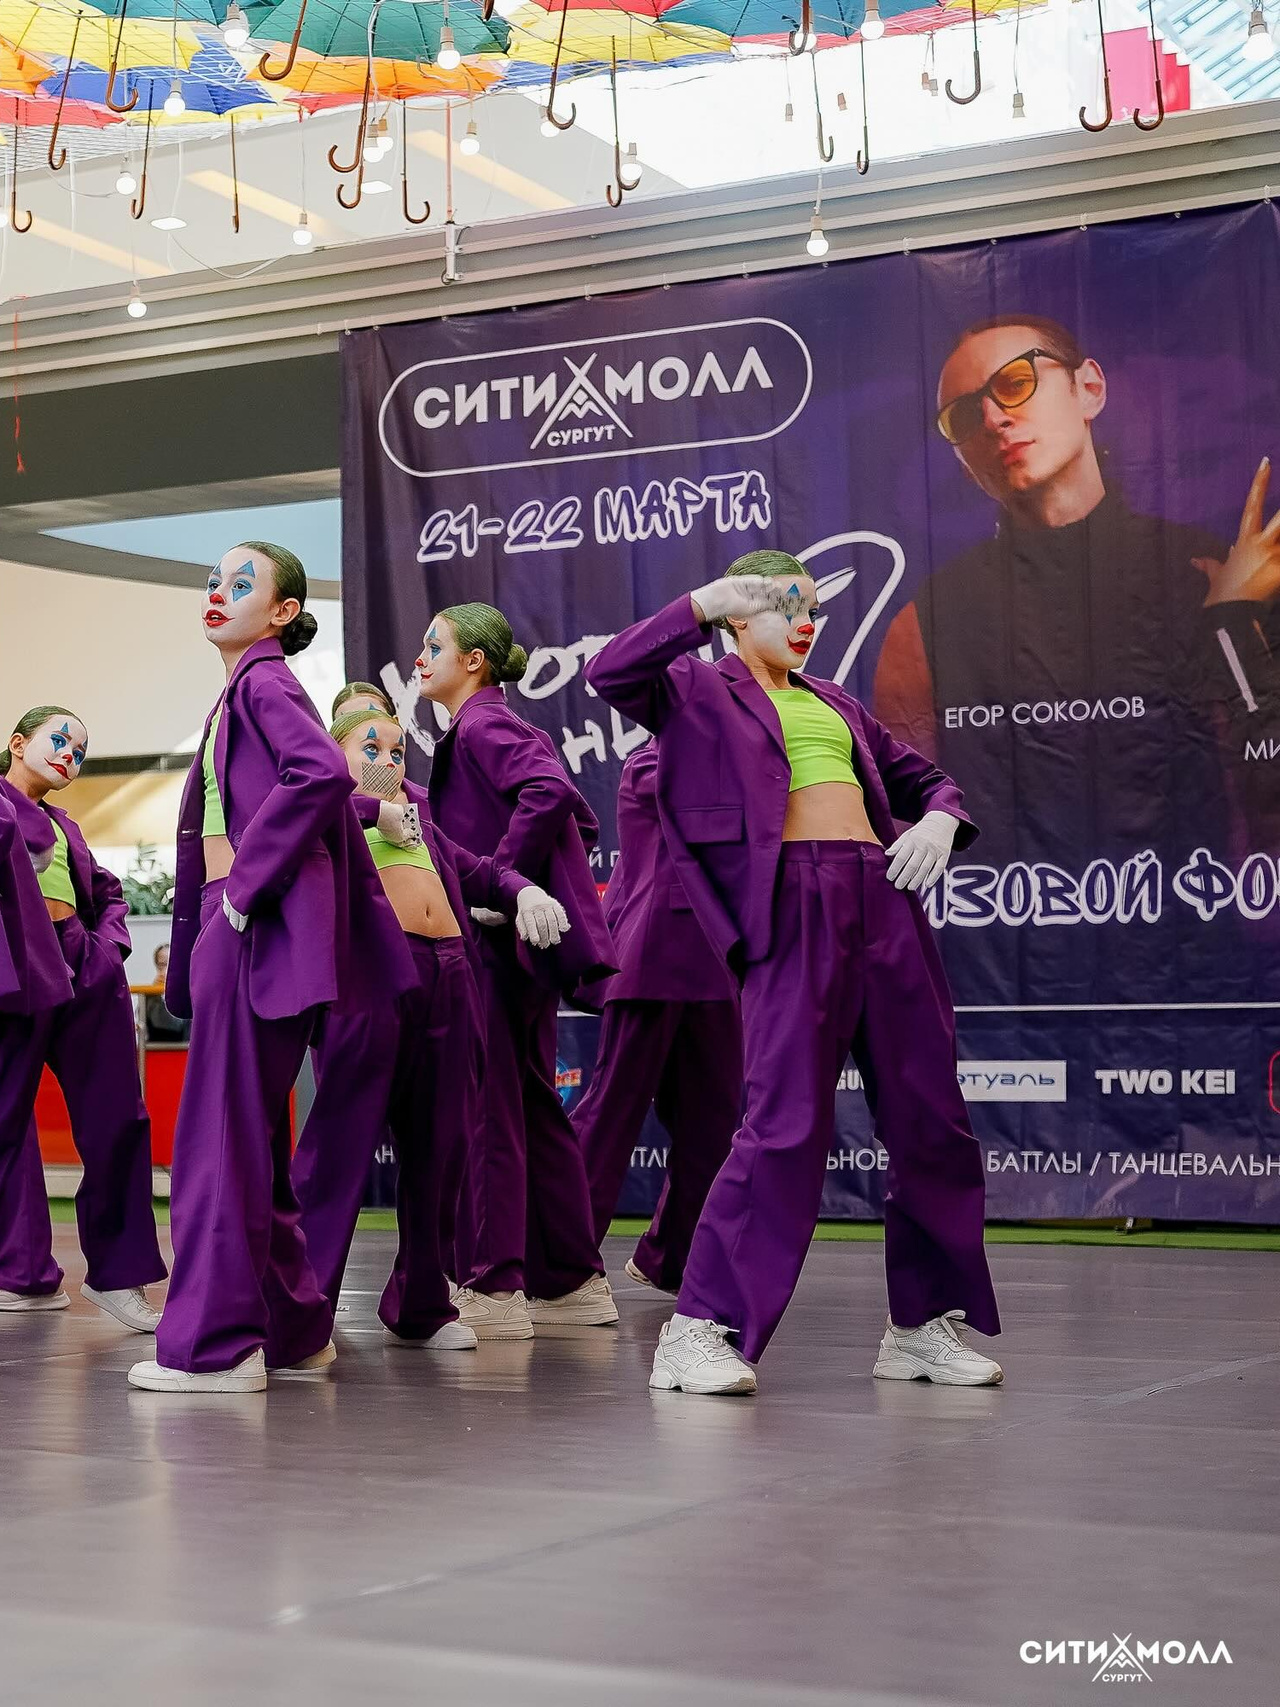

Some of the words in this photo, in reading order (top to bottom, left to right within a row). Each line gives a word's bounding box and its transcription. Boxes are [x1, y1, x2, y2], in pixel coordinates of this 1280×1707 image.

[413, 371, 558, 430] СИТИ
[604, 346, 774, 405] МОЛЛ
[546, 424, 616, 448] СУРГУТ
[416, 496, 583, 563] 21-22
[593, 470, 772, 545] МАРТА
[944, 704, 1005, 729] ЕГОР
[1011, 696, 1146, 726] СОКОЛОВ
[920, 848, 1163, 930] ИЗОВОЙ
[1094, 1069, 1173, 1095] TWO
[1181, 1069, 1236, 1095] KEI
[986, 1150, 1082, 1175] БАТТЛЫ
[1109, 1152, 1280, 1177] ТАНЦЕВАЛЬН
